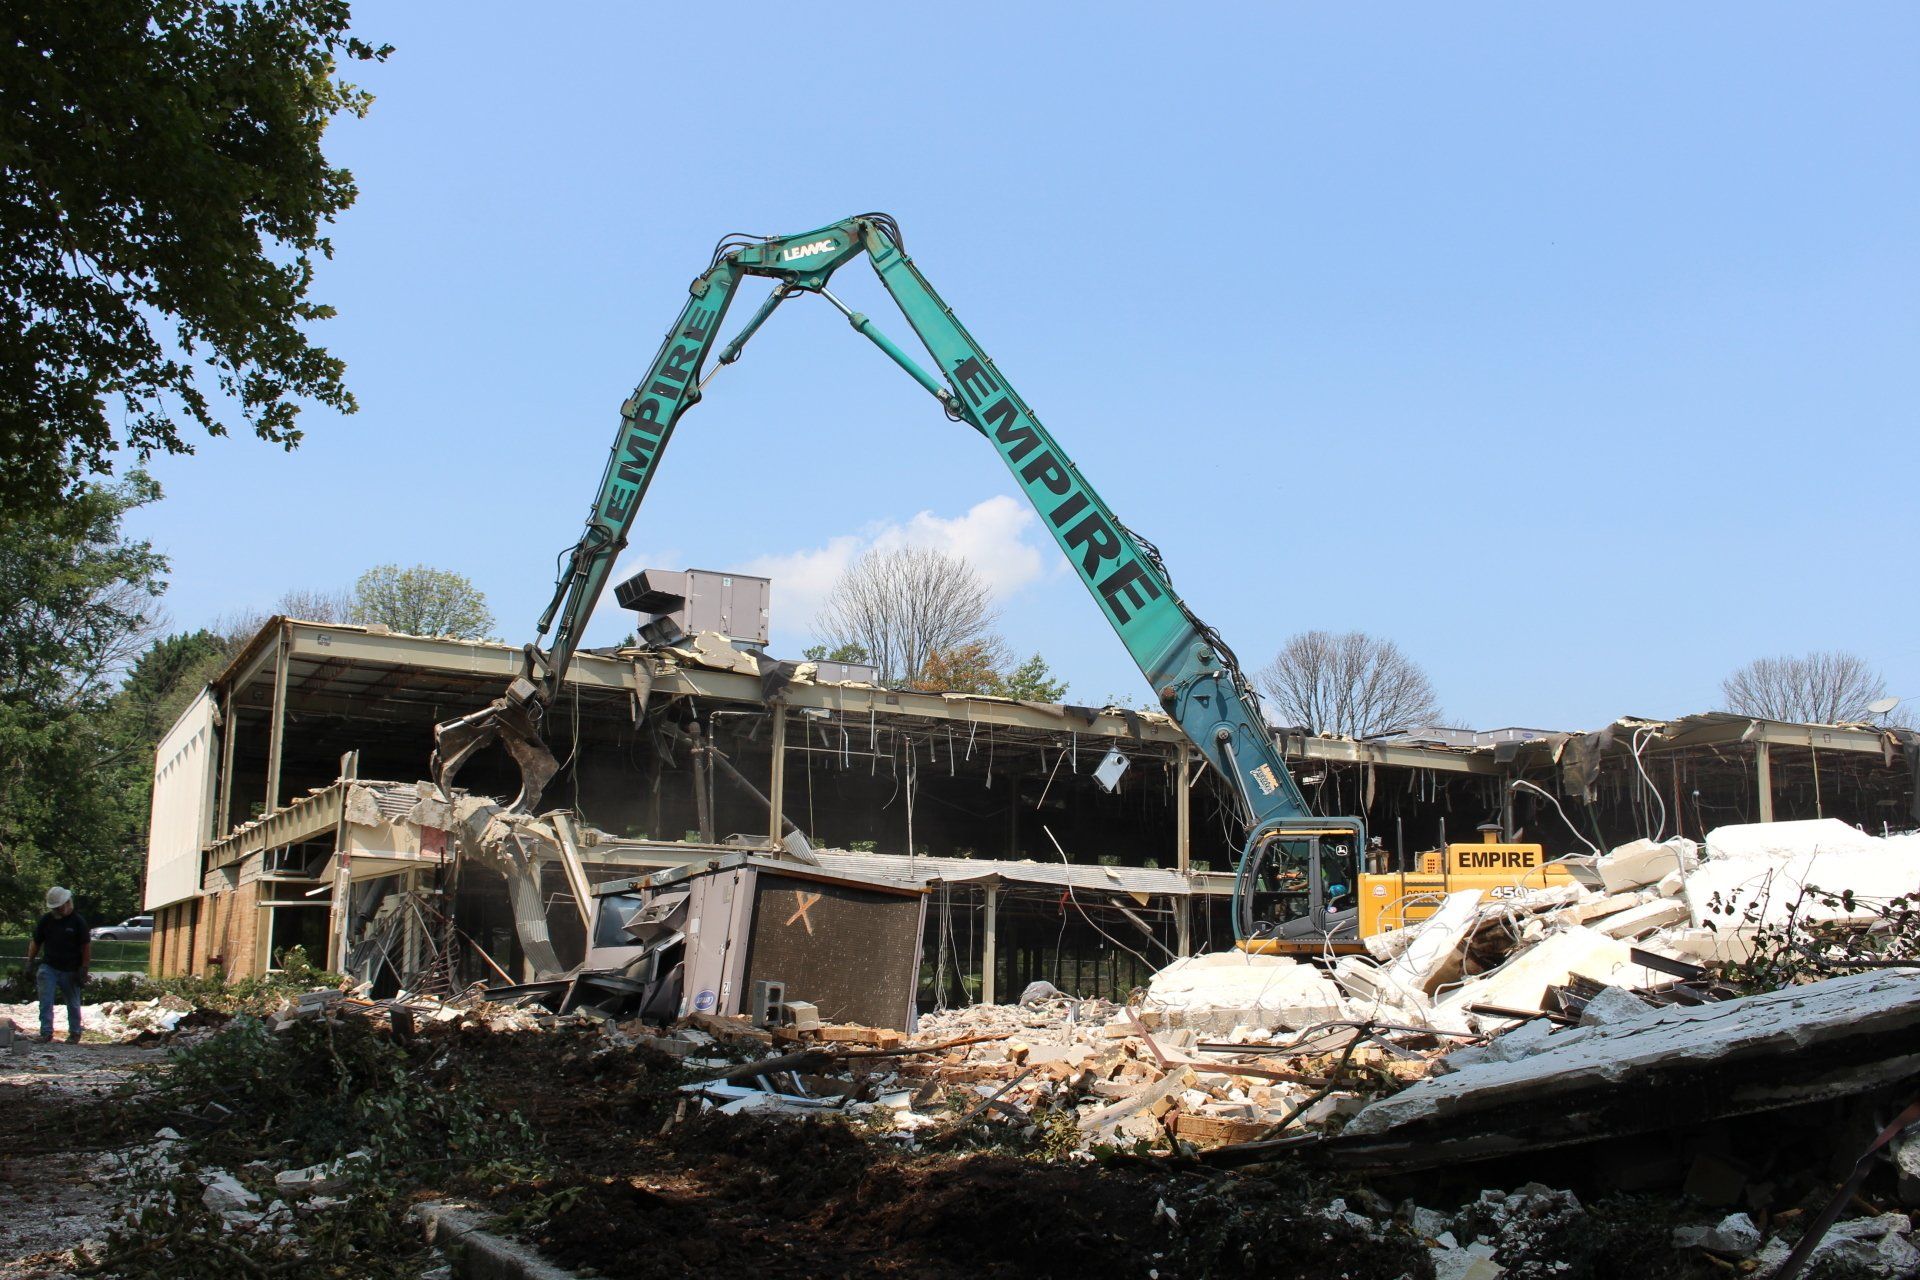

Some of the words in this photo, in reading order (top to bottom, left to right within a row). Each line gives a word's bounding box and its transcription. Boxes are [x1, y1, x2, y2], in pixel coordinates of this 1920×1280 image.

[783, 239, 836, 262] LEMAC
[604, 306, 716, 523] EMPIRE
[953, 355, 1162, 626] EMPIRE
[1458, 852, 1535, 868] EMPIRE
